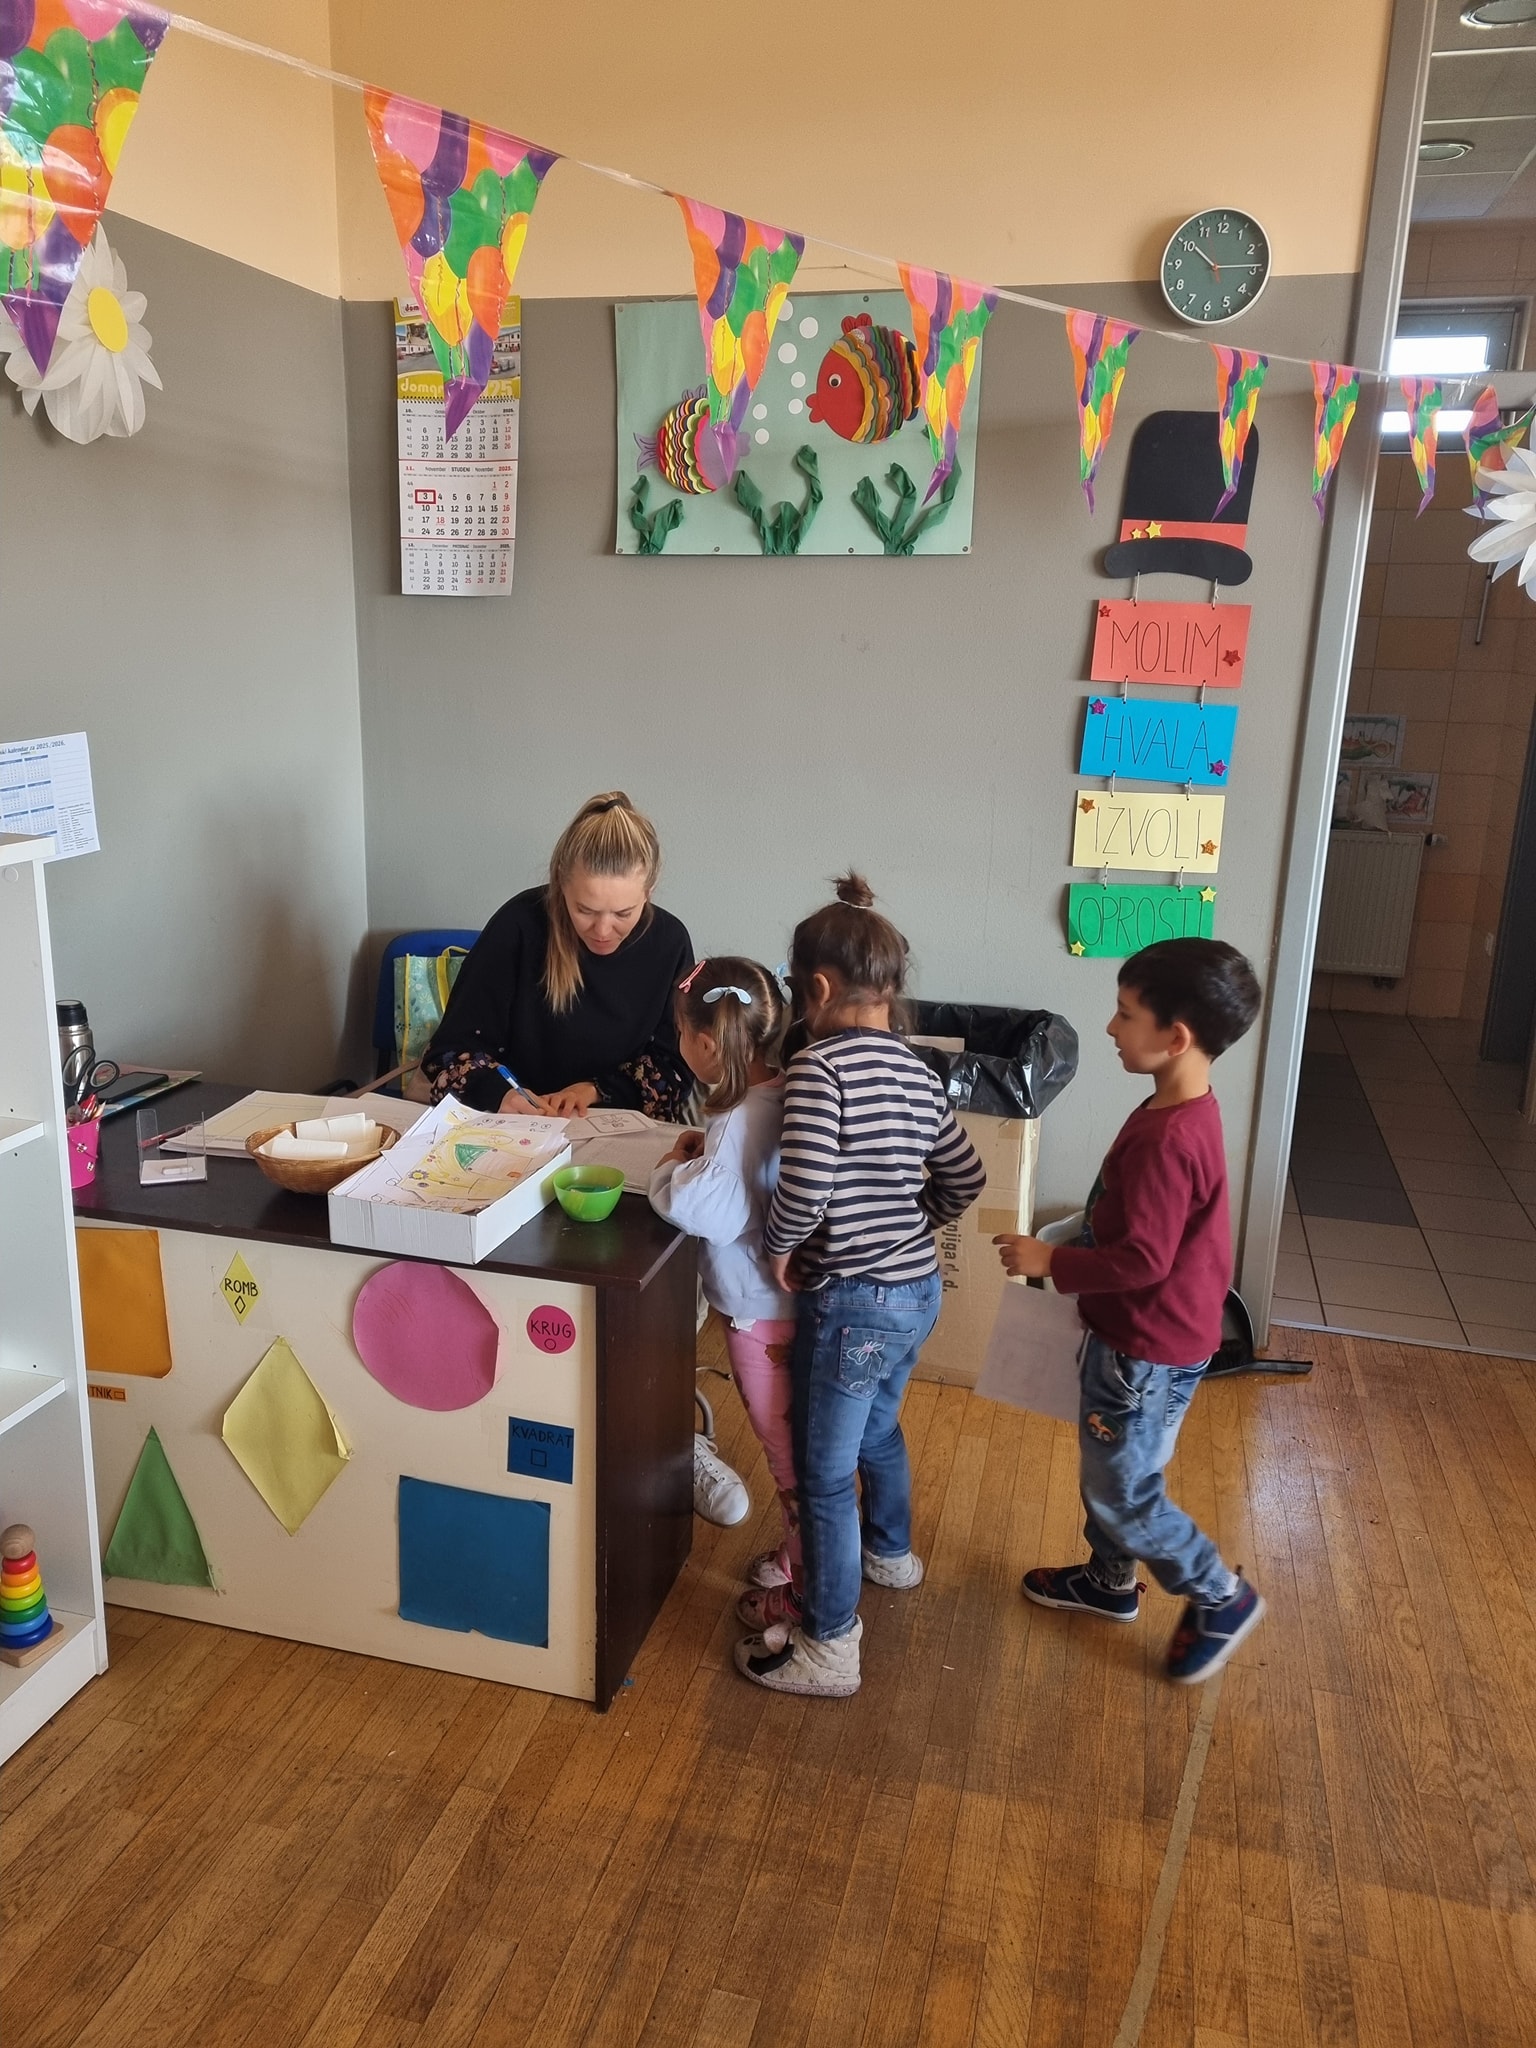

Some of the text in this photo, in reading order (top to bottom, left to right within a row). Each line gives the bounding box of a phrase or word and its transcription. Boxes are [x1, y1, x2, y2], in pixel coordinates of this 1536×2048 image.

[1200, 226, 1210, 238] 11
[1217, 222, 1230, 234] 12
[1238, 229, 1244, 241] 1
[1183, 240, 1196, 252] 10
[1246, 243, 1256, 255] 2
[1174, 258, 1183, 270] 9
[1249, 265, 1257, 275] 3
[1176, 278, 1185, 290] 8
[1237, 282, 1247, 295] 4
[1188, 293, 1197, 305] 7
[1222, 295, 1231, 308] 5
[1203, 300, 1211, 312] 6
[1110, 620, 1222, 678] MOLIM
[1101, 714, 1210, 771] HVALA
[1095, 806, 1201, 860] IZVOLI
[1078, 896, 1204, 949] OPROSTI
[224, 1277, 259, 1297] ROMB
[530, 1319, 572, 1339] KRUG
[88, 1385, 113, 1400] TNIK
[512, 1424, 573, 1449] KVADRAT
